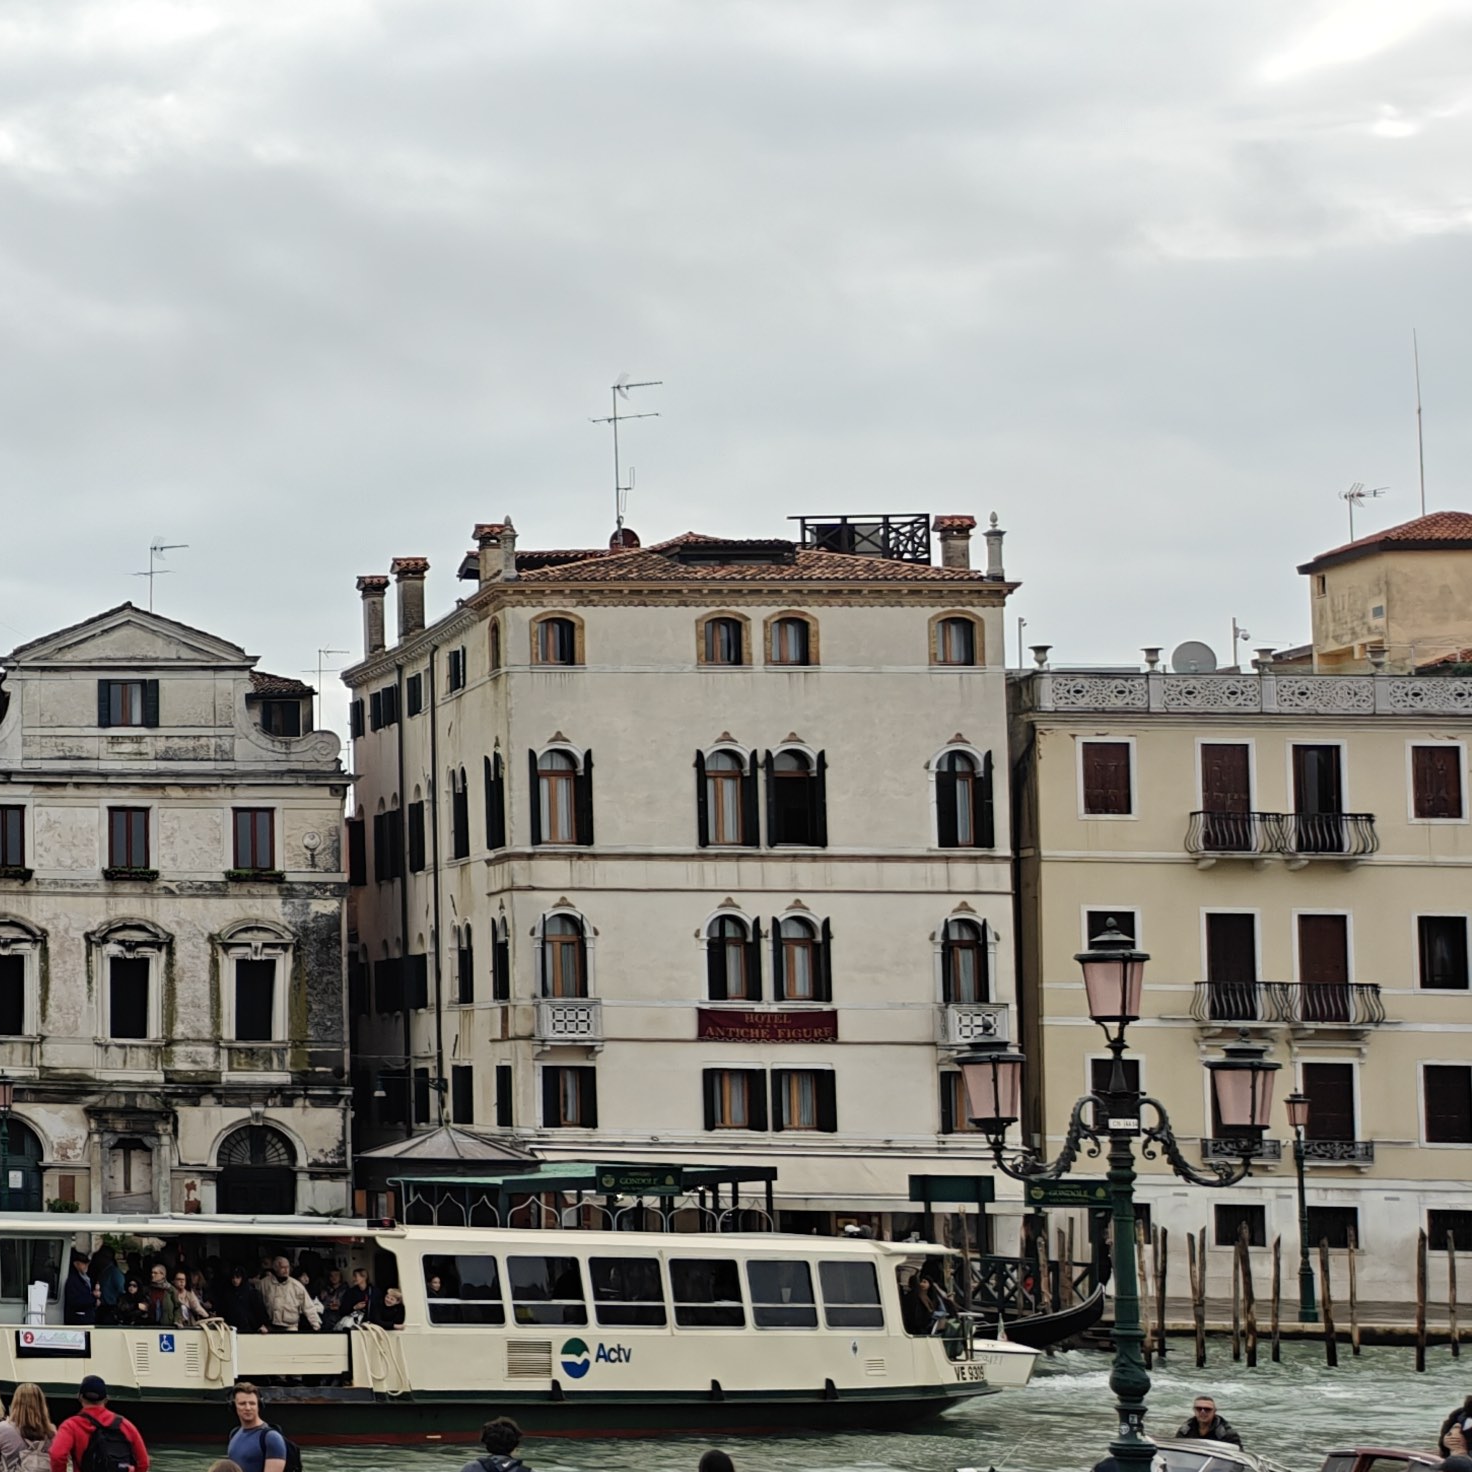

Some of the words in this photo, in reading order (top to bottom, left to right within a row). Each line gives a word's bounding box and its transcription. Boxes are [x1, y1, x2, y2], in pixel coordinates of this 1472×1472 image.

[745, 1013, 792, 1024] HOTEL
[706, 1026, 770, 1038] ANTICHE
[778, 1026, 832, 1038] FIGURE
[595, 1343, 632, 1363] Actv
[954, 1366, 967, 1381] VE
